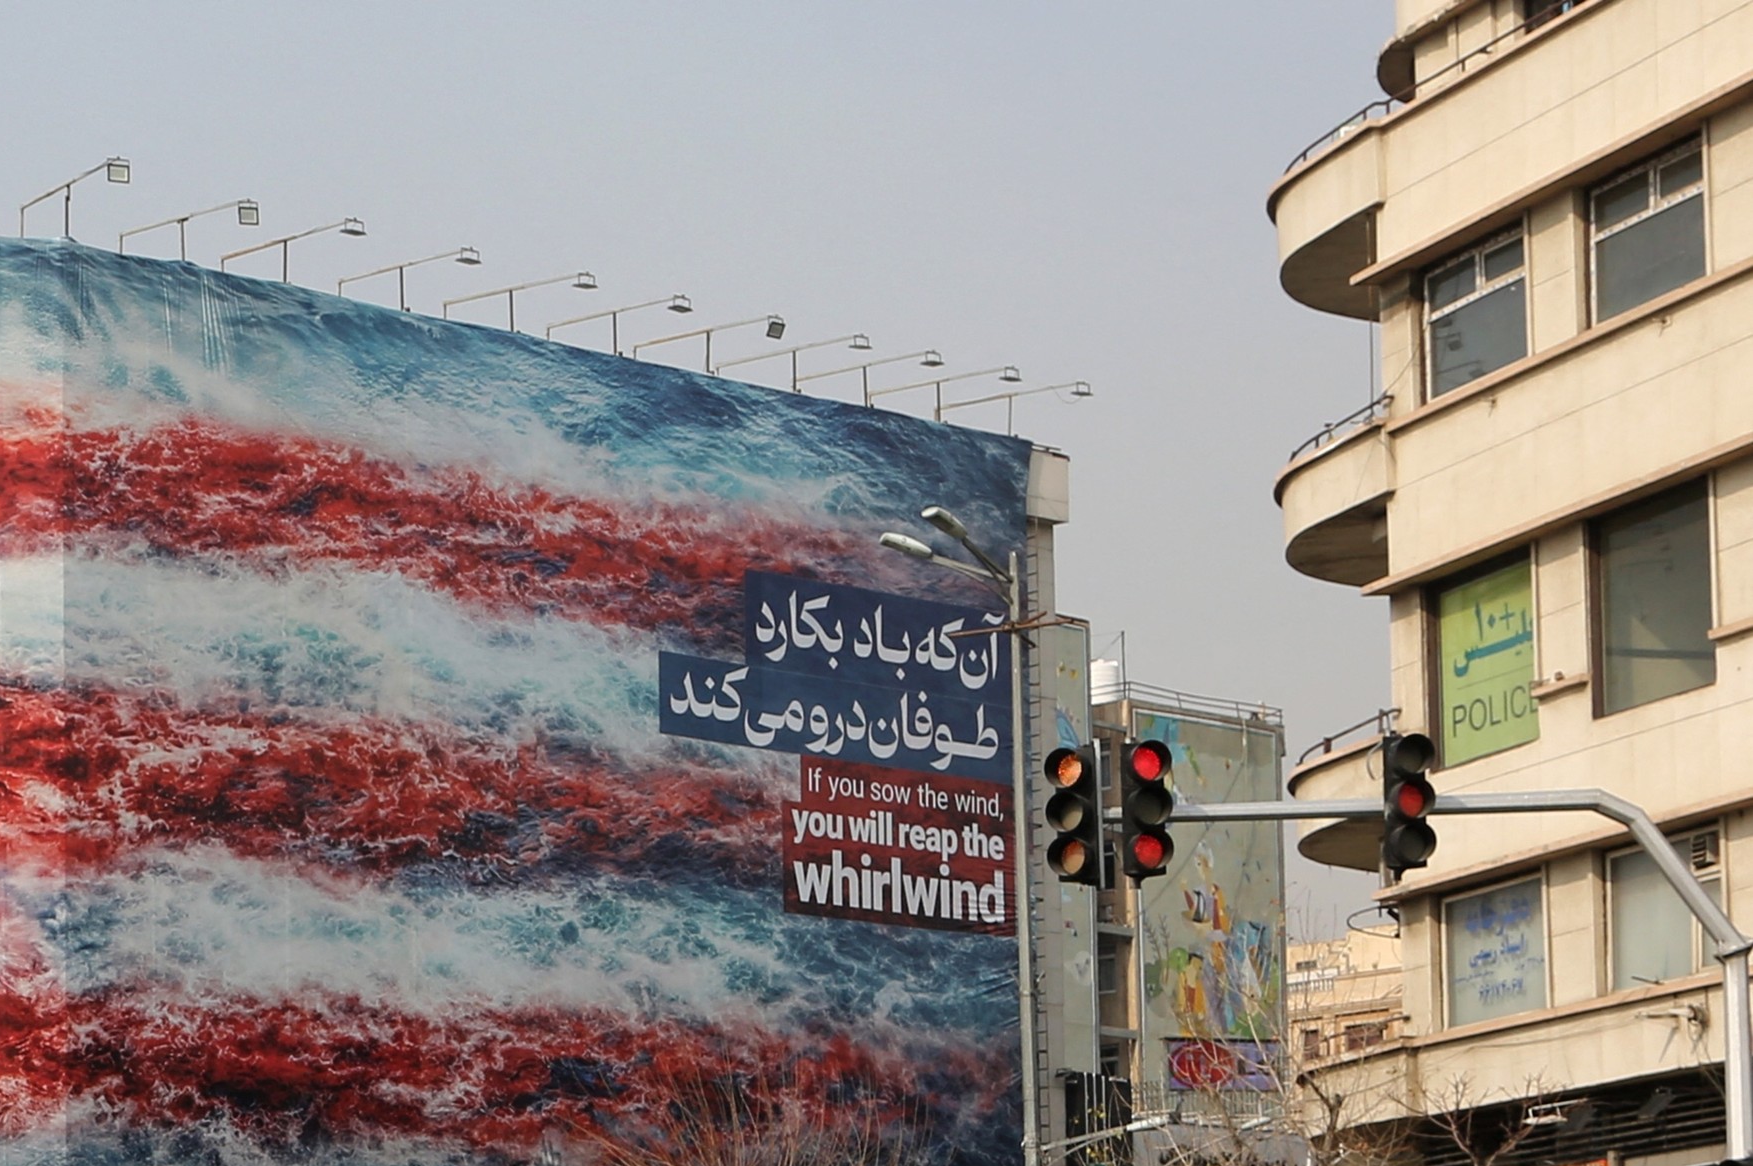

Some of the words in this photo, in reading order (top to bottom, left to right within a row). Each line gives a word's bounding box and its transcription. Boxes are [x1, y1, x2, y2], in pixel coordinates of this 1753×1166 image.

[756, 590, 844, 670] بکارد
[854, 604, 911, 680] باد
[805, 700, 867, 755] درو
[869, 690, 999, 770] طوفان
[807, 767, 823, 793] If
[828, 775, 864, 801] you
[870, 781, 911, 805] sow
[917, 783, 949, 810] the
[954, 790, 1005, 822] wind,
[791, 808, 844, 843] you
[848, 810, 893, 847] will
[898, 822, 958, 862] reap
[961, 823, 1005, 860] the
[793, 849, 1005, 923] whirlwind
